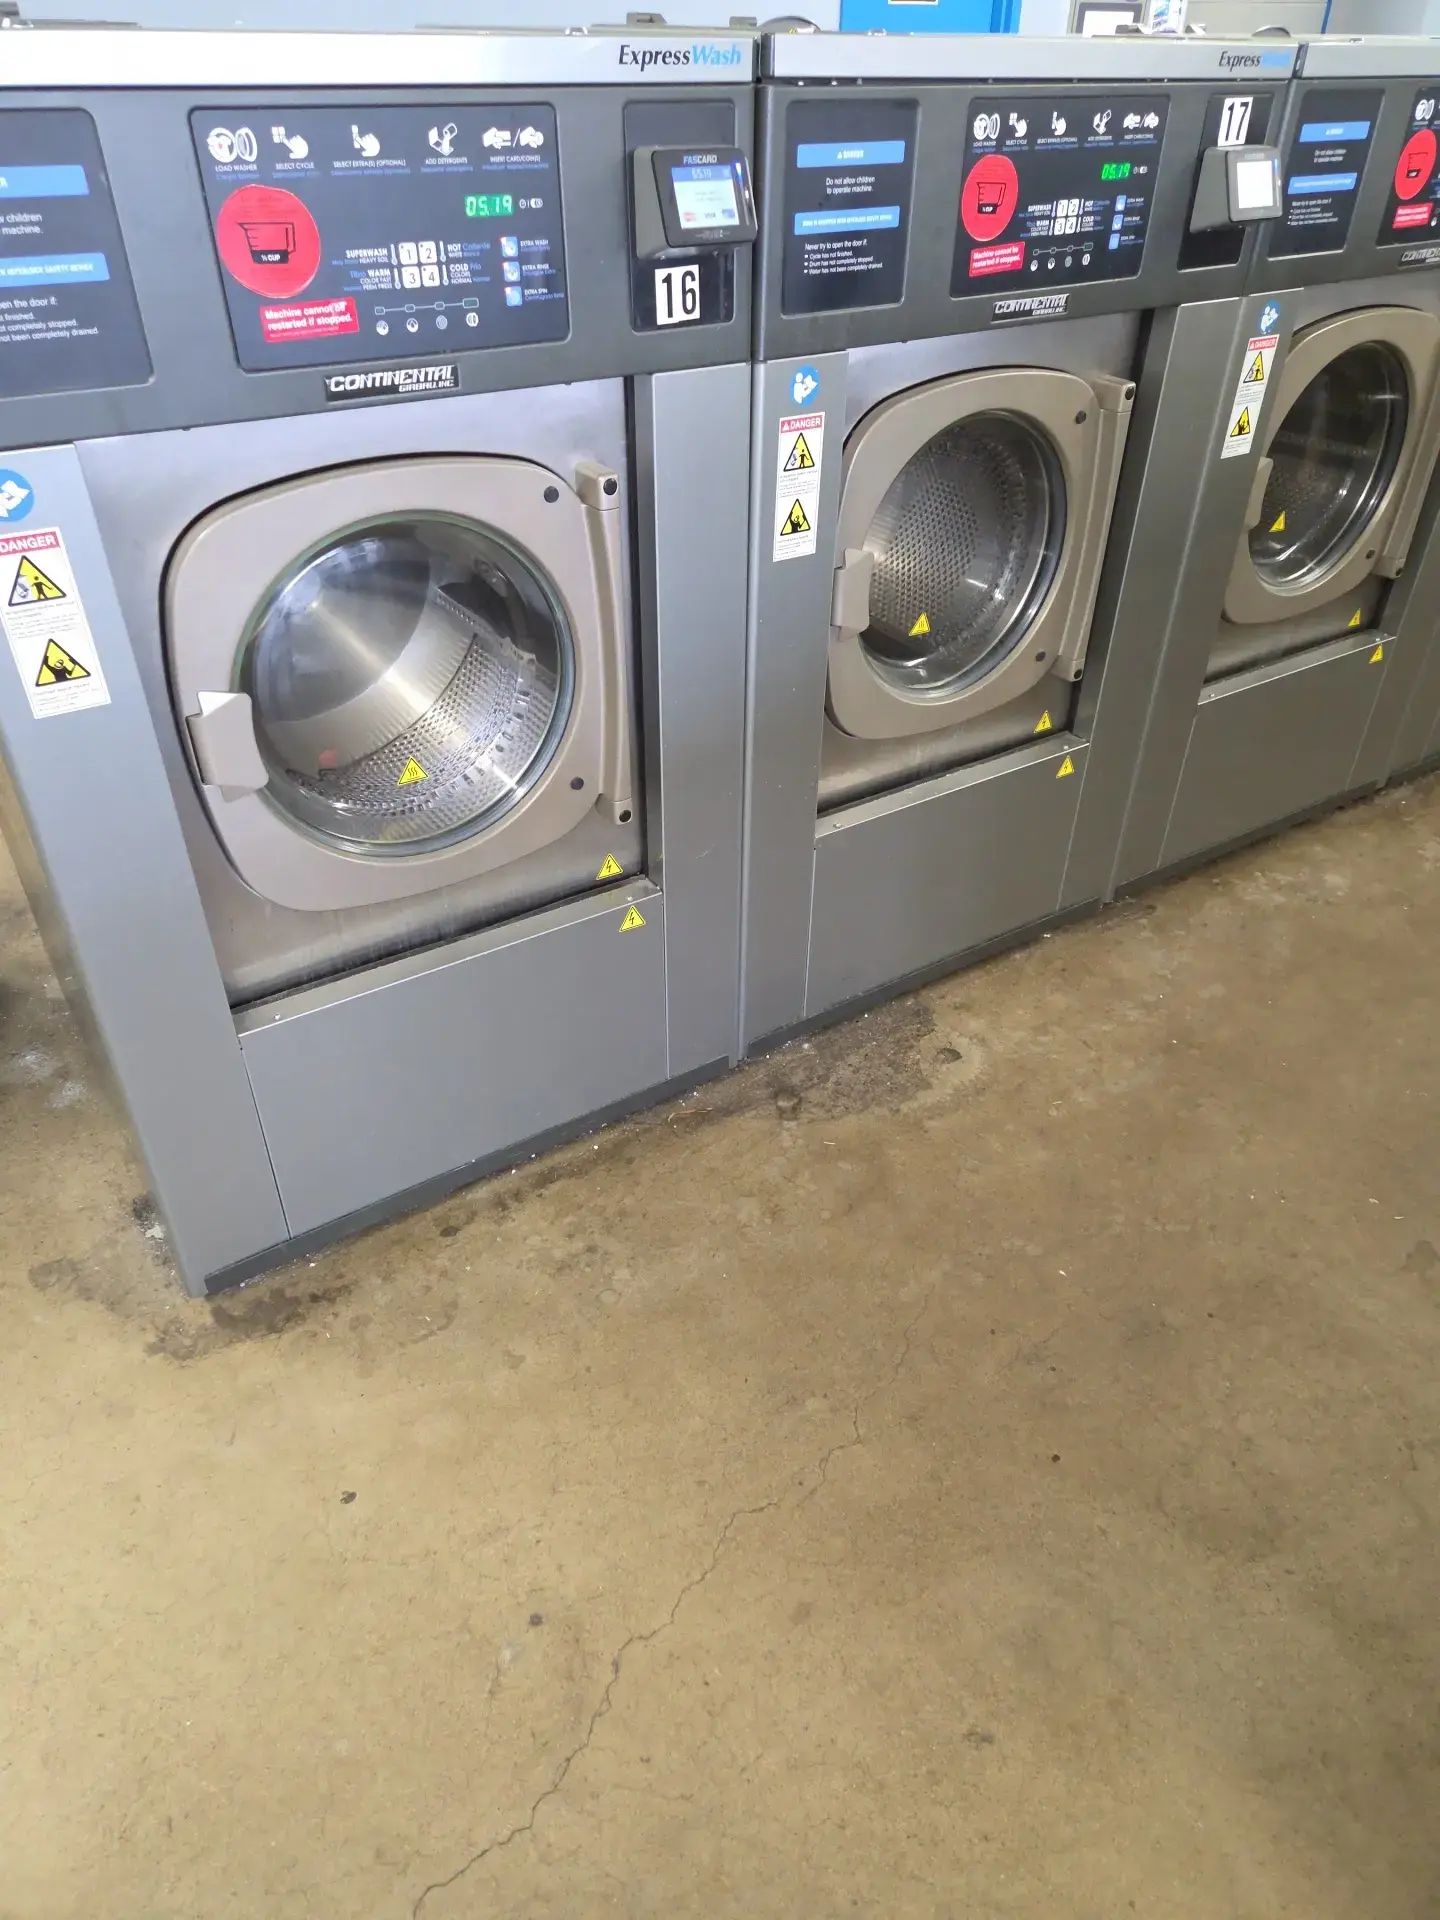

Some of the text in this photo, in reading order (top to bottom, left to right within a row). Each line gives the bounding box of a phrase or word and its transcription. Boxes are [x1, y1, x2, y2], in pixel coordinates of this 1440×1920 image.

[618, 44, 742, 72] ExpressWash
[1225, 101, 1249, 142] 17
[826, 178, 834, 186] Do
[6, 213, 42, 223] children
[2, 226, 43, 236] machine.
[346, 248, 388, 258] SUPERWASH
[448, 243, 461, 252] HOT
[426, 248, 432, 260] 2
[368, 268, 390, 278] WARM
[450, 263, 468, 272] COLD
[410, 272, 435, 284] 3 4
[662, 270, 696, 318] 16
[14, 299, 28, 308] the
[30, 298, 48, 307] door
[12, 332, 30, 342] been
[32, 328, 70, 341] completely
[330, 364, 454, 392] CONTINENTAL
[790, 418, 820, 430] DANGER
[0, 535, 56, 552] DANGER
